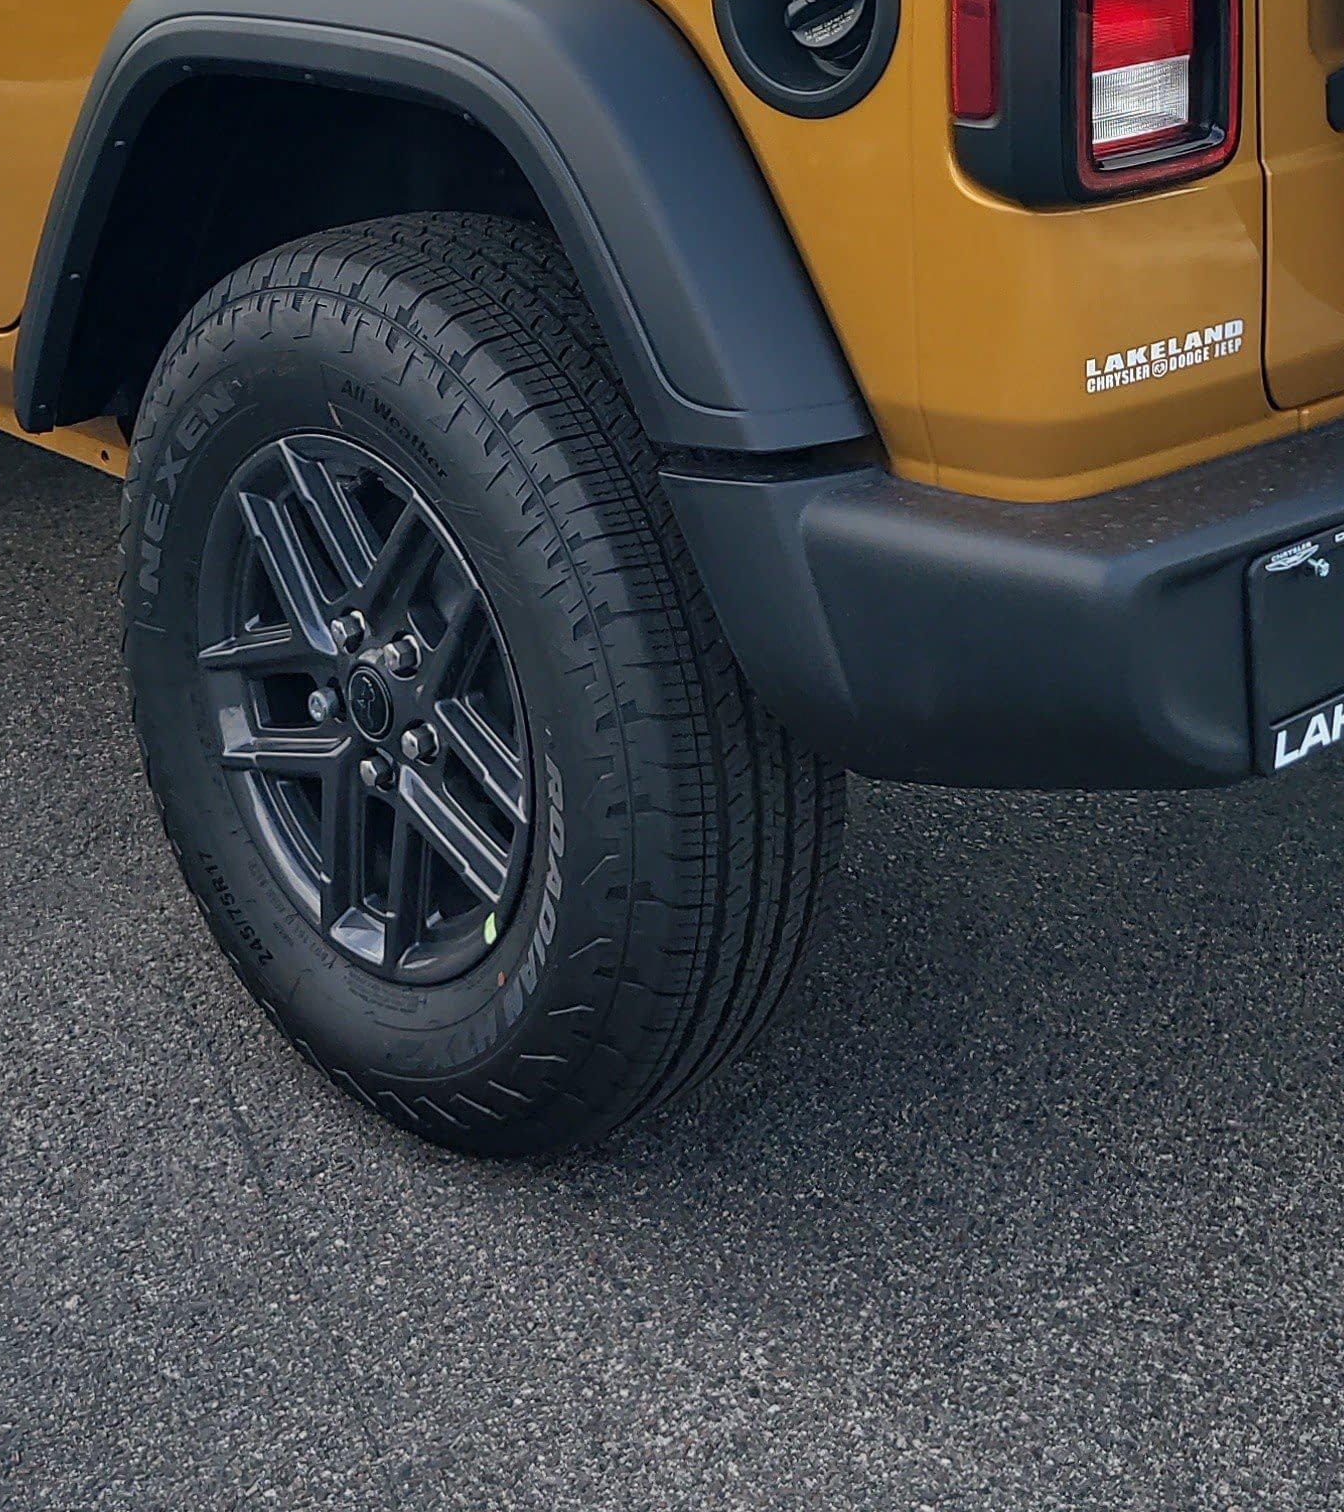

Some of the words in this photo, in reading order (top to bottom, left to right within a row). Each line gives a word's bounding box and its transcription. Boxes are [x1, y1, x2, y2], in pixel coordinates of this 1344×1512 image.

[1086, 319, 1244, 378] LAKELAND
[1087, 366, 1150, 394] CHRYSLER
[1169, 347, 1210, 371] DODGE
[1214, 338, 1243, 358] JEEP
[139, 381, 236, 595] NEXEN
[503, 752, 565, 1028] ROADIAN
